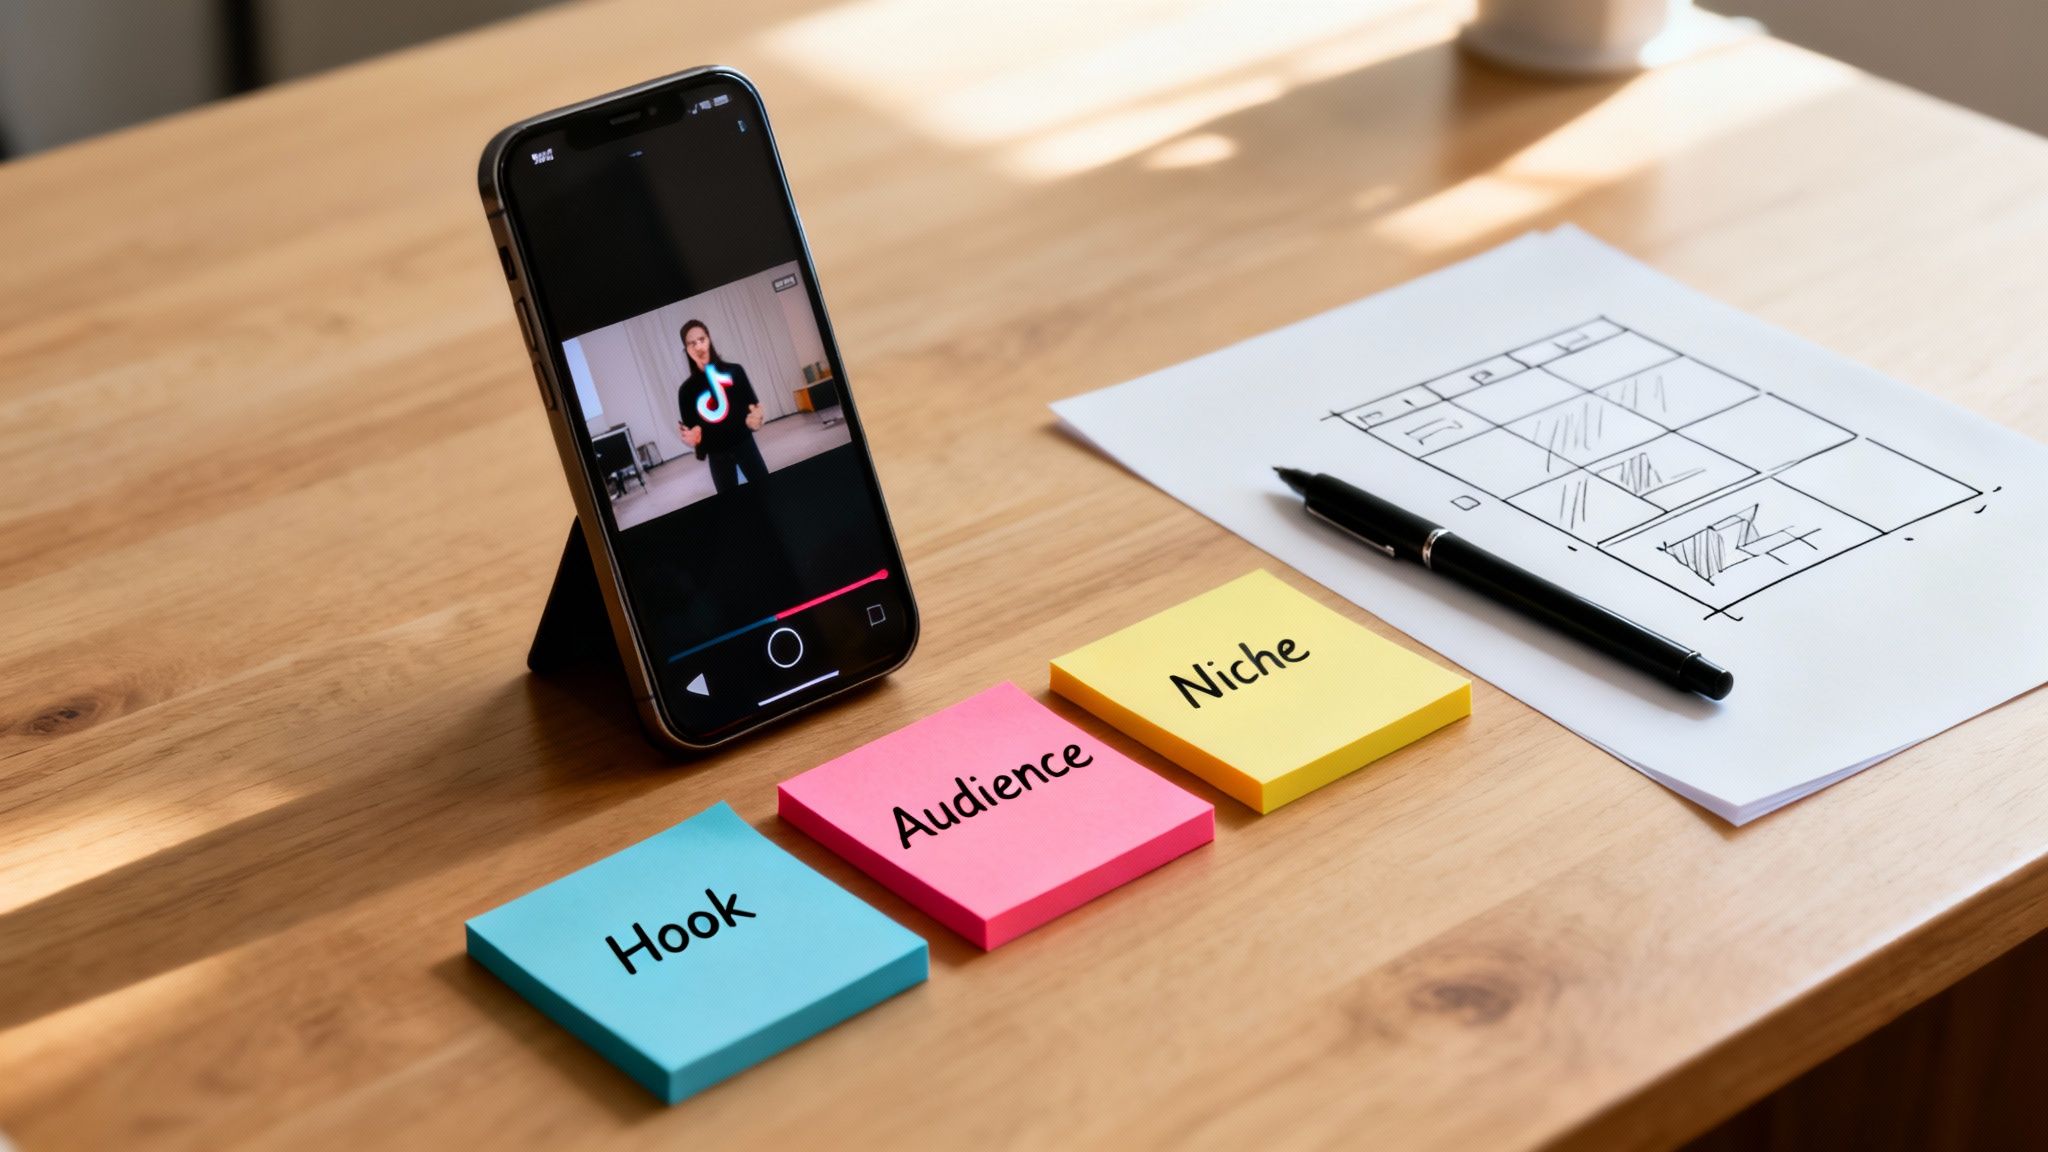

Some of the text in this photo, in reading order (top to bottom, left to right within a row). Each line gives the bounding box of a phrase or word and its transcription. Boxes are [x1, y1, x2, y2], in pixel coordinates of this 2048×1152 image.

[1169, 635, 1310, 709] Niche
[891, 741, 1094, 850] Audience
[604, 888, 757, 975] Hook
